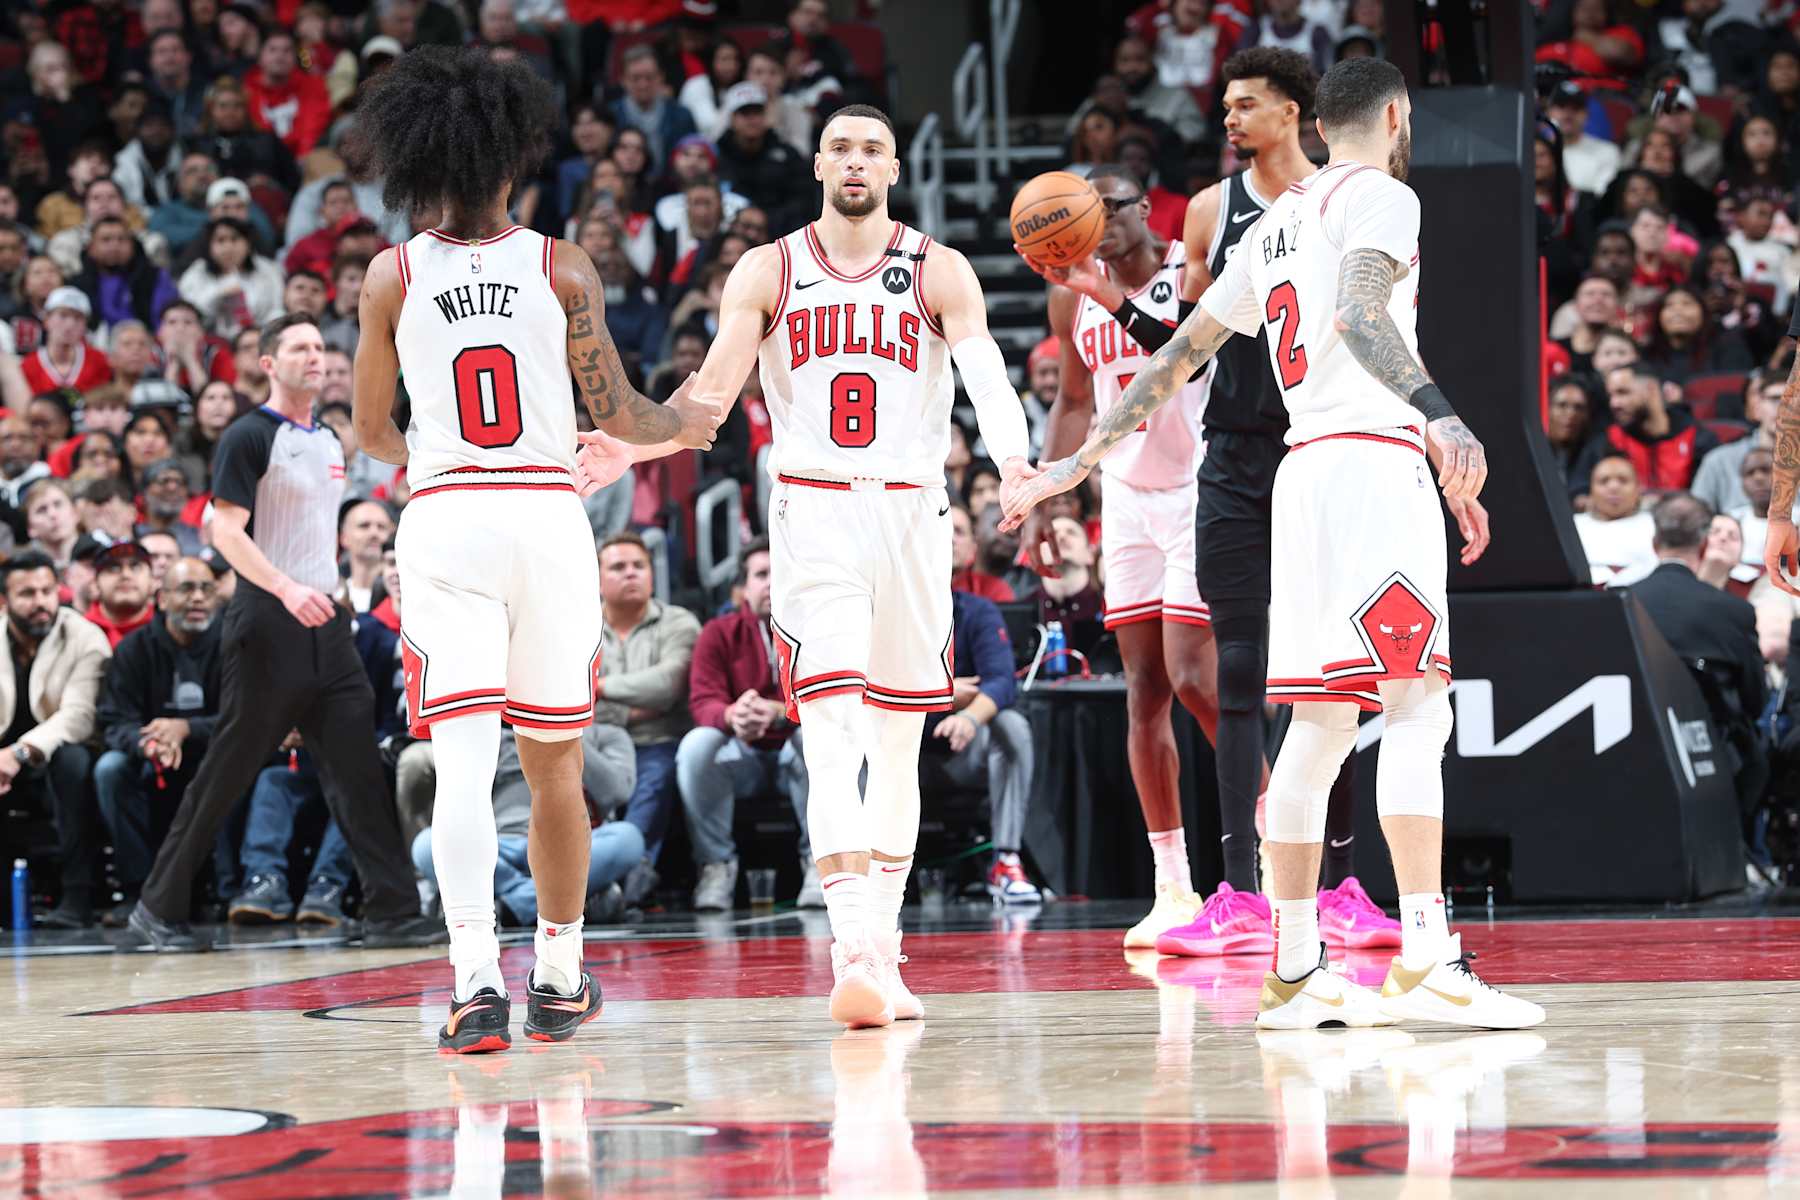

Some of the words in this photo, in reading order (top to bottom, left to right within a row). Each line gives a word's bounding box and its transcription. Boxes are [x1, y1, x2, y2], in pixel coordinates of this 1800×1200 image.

[1015, 207, 1071, 239] Wilson
[433, 283, 519, 324] WHITE
[786, 303, 921, 373] BULLS
[1265, 280, 1308, 391] 2
[1082, 319, 1178, 375] BUL
[453, 344, 523, 449] 0
[830, 372, 876, 448] 8
